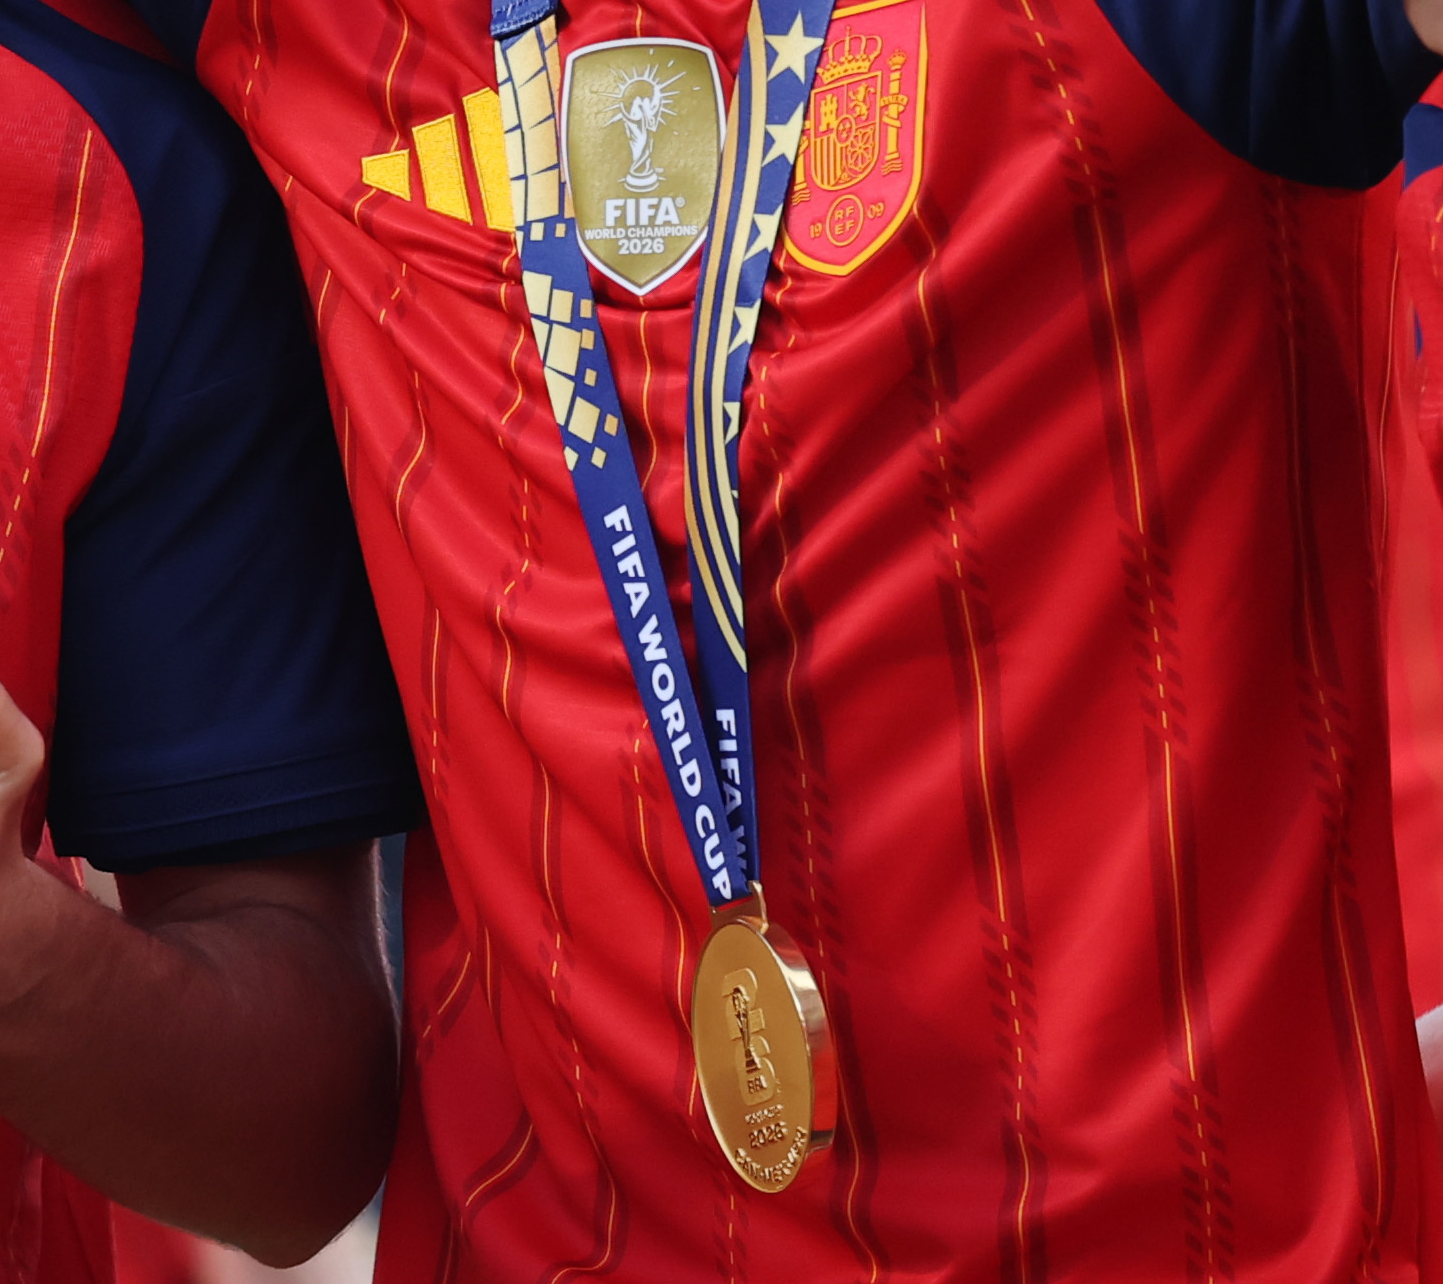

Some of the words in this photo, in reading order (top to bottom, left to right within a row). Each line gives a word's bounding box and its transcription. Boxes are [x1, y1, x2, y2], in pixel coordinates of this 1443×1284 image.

[604, 196, 681, 227] FIFA
[809, 221, 823, 238] 19
[866, 202, 885, 220] 09
[584, 227, 626, 240] WORLD
[627, 225, 699, 238] CHAMPIONS
[617, 238, 665, 255] 2026
[604, 504, 651, 619] FIFA
[638, 614, 702, 797] WORLD
[695, 804, 732, 901] CUP
[716, 708, 744, 817] FIFA
[749, 1121, 788, 1149] 2026
